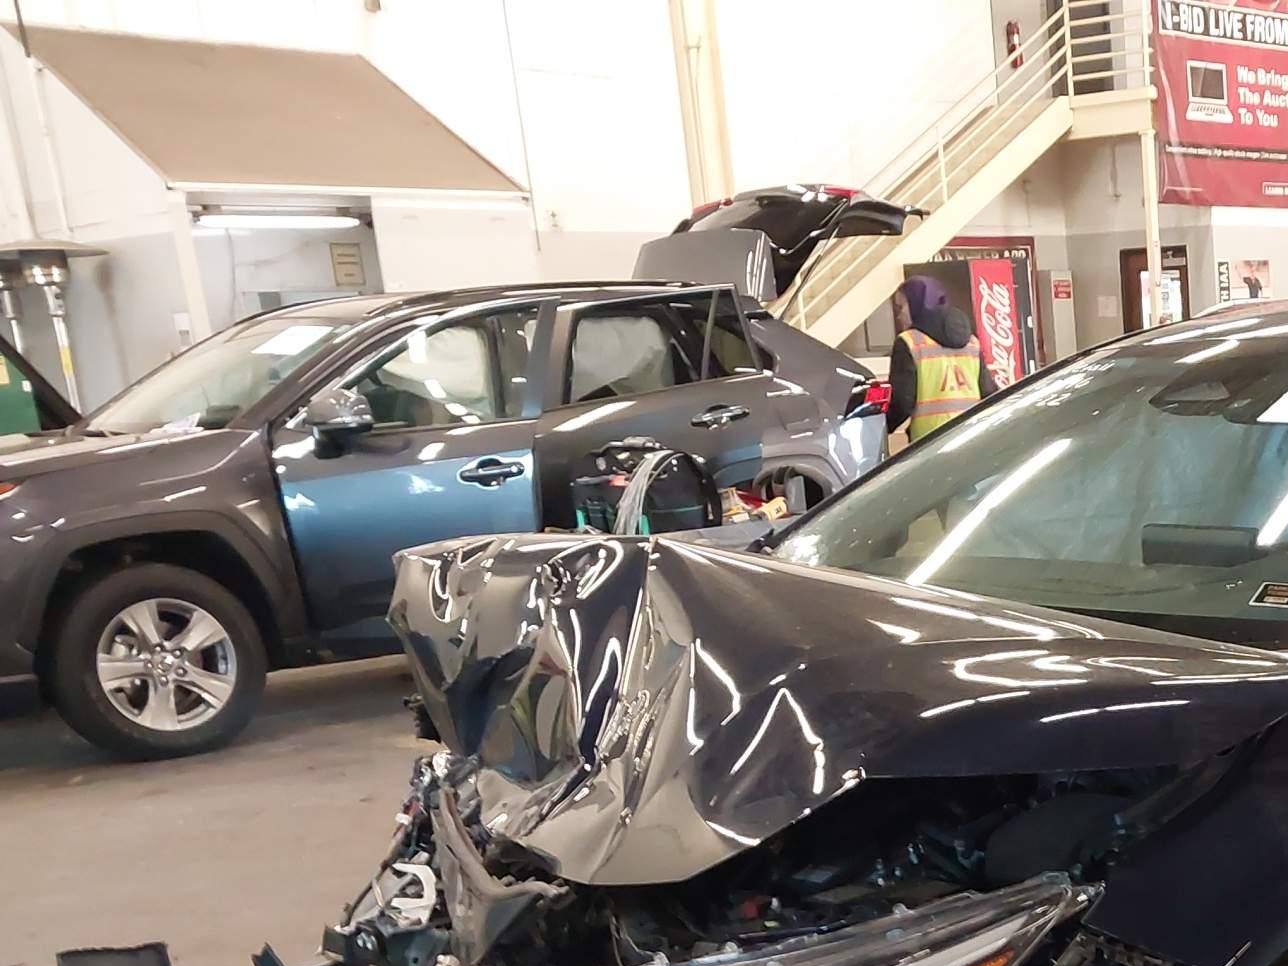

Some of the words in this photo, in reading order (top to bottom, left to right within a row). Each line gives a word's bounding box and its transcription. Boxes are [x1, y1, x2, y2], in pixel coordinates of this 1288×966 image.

[1209, 8, 1243, 39] LIVE
[1237, 65, 1256, 84] We
[1238, 87, 1261, 105] The
[1238, 107, 1253, 125] To
[1256, 108, 1279, 127] You
